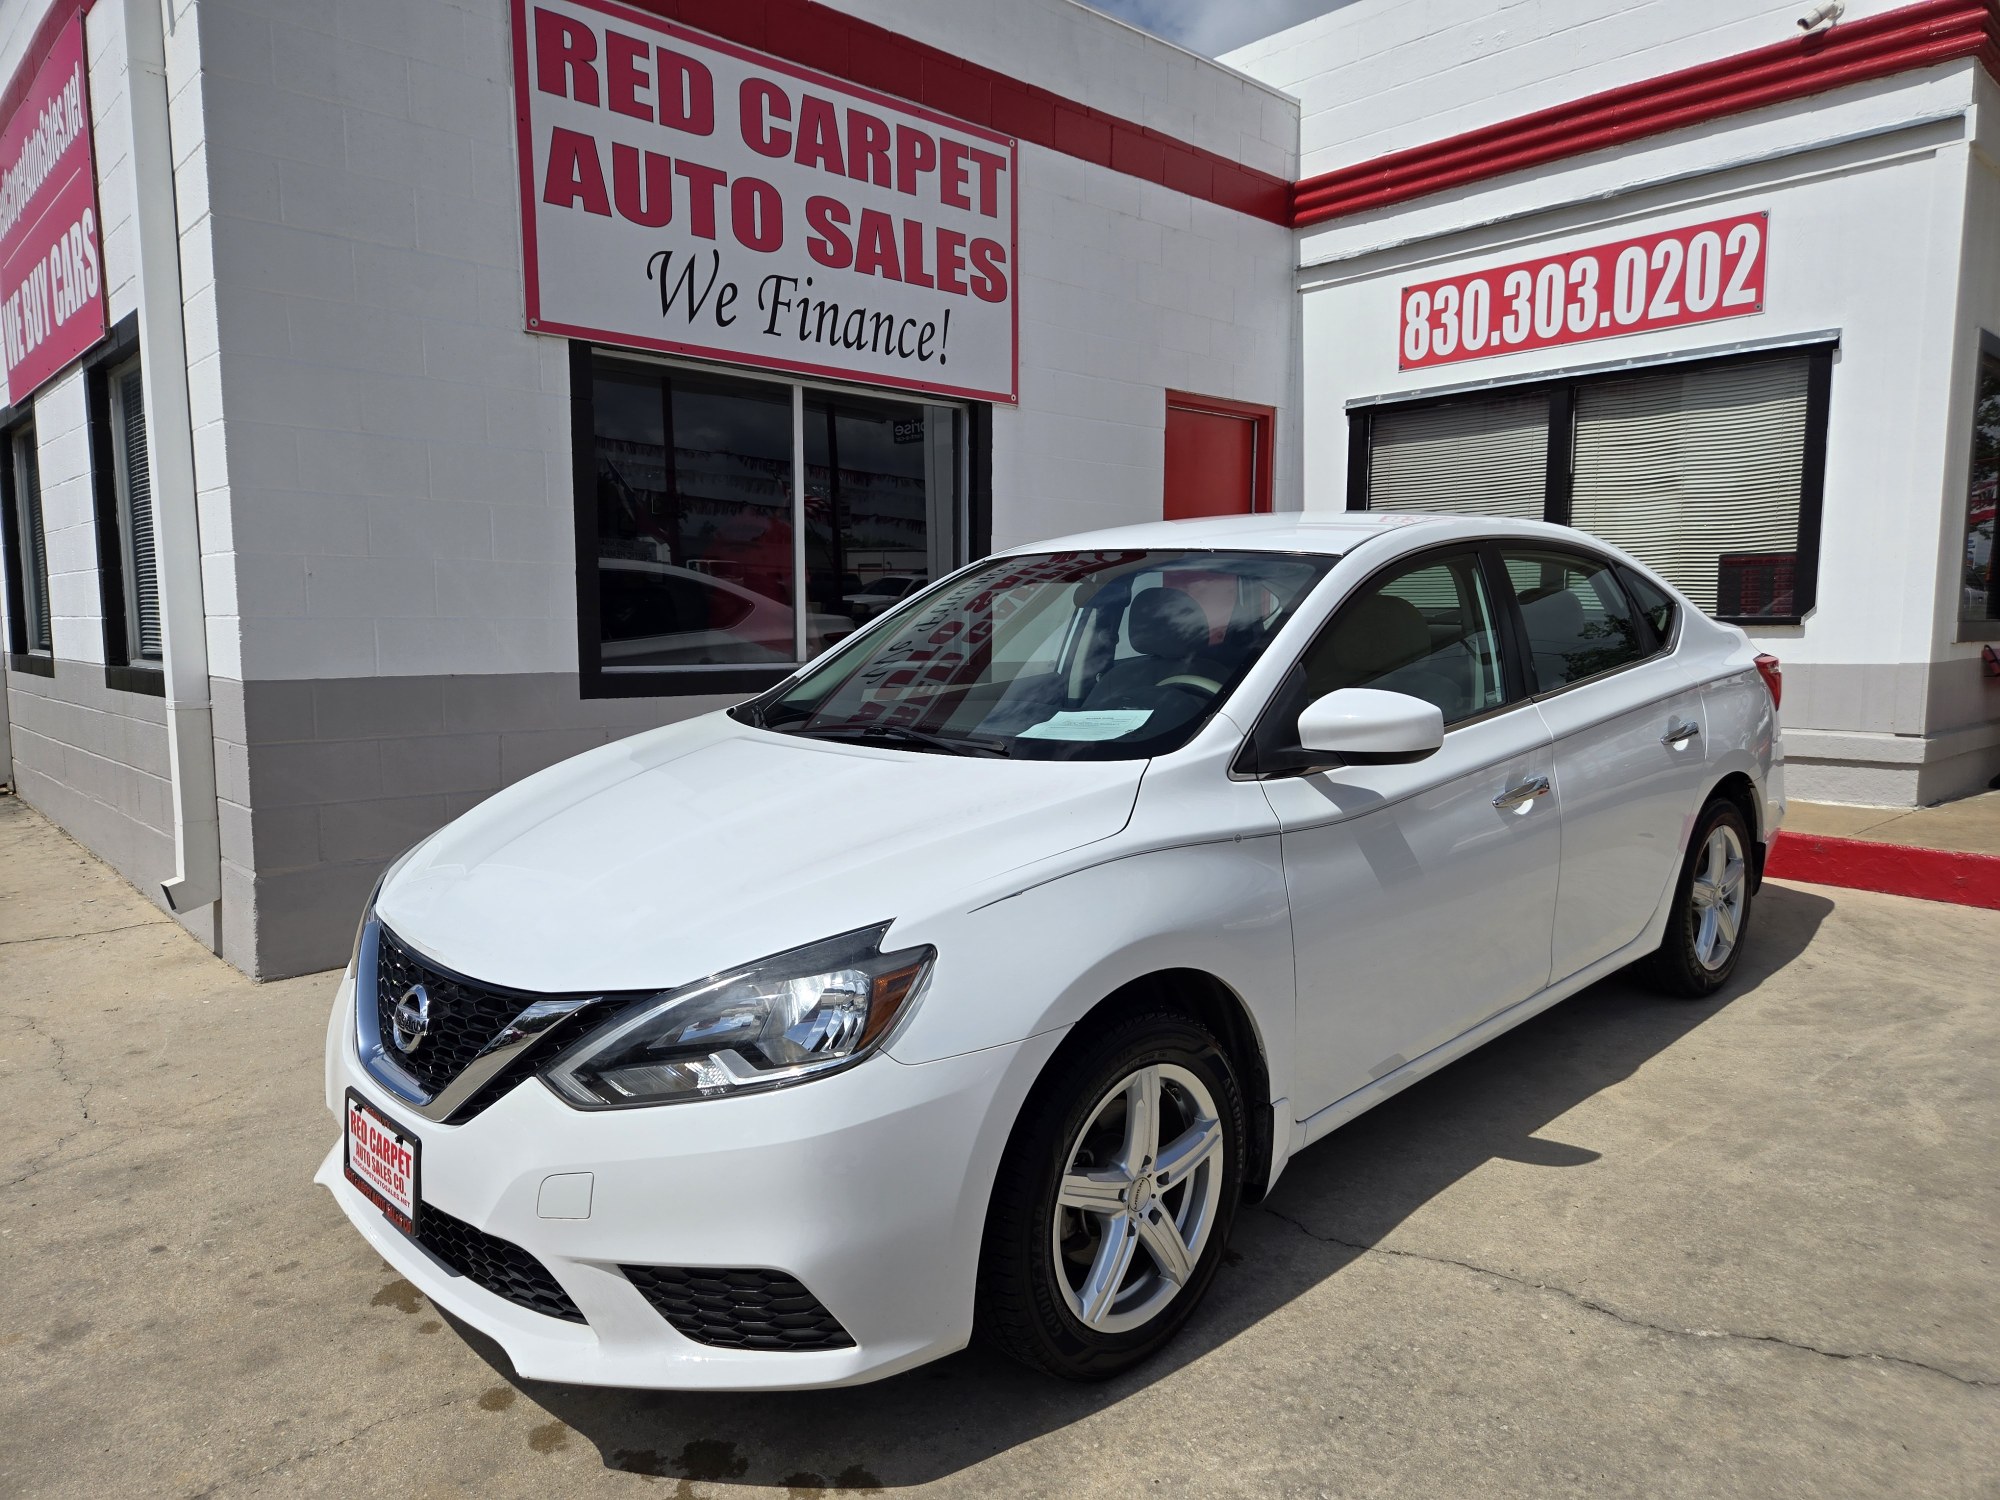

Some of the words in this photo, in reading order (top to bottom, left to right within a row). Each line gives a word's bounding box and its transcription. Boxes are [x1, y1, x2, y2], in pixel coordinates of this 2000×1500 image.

[533, 6, 715, 136] RED
[739, 77, 1007, 219] CARPET
[543, 125, 783, 253] AUTO
[805, 195, 1008, 303] SALES
[2, 286, 26, 372] WE
[25, 256, 53, 353] BUY
[51, 207, 98, 327] CARS
[646, 249, 738, 328] We
[758, 275, 951, 366] Finance!
[1404, 223, 1761, 361] 830.303.0202
[350, 1109, 368, 1146] RED
[370, 1126, 412, 1179] CARPET
[355, 1142, 371, 1166] AUTO
[371, 1155, 392, 1187] SALES
[393, 1171, 407, 1197] CO.
